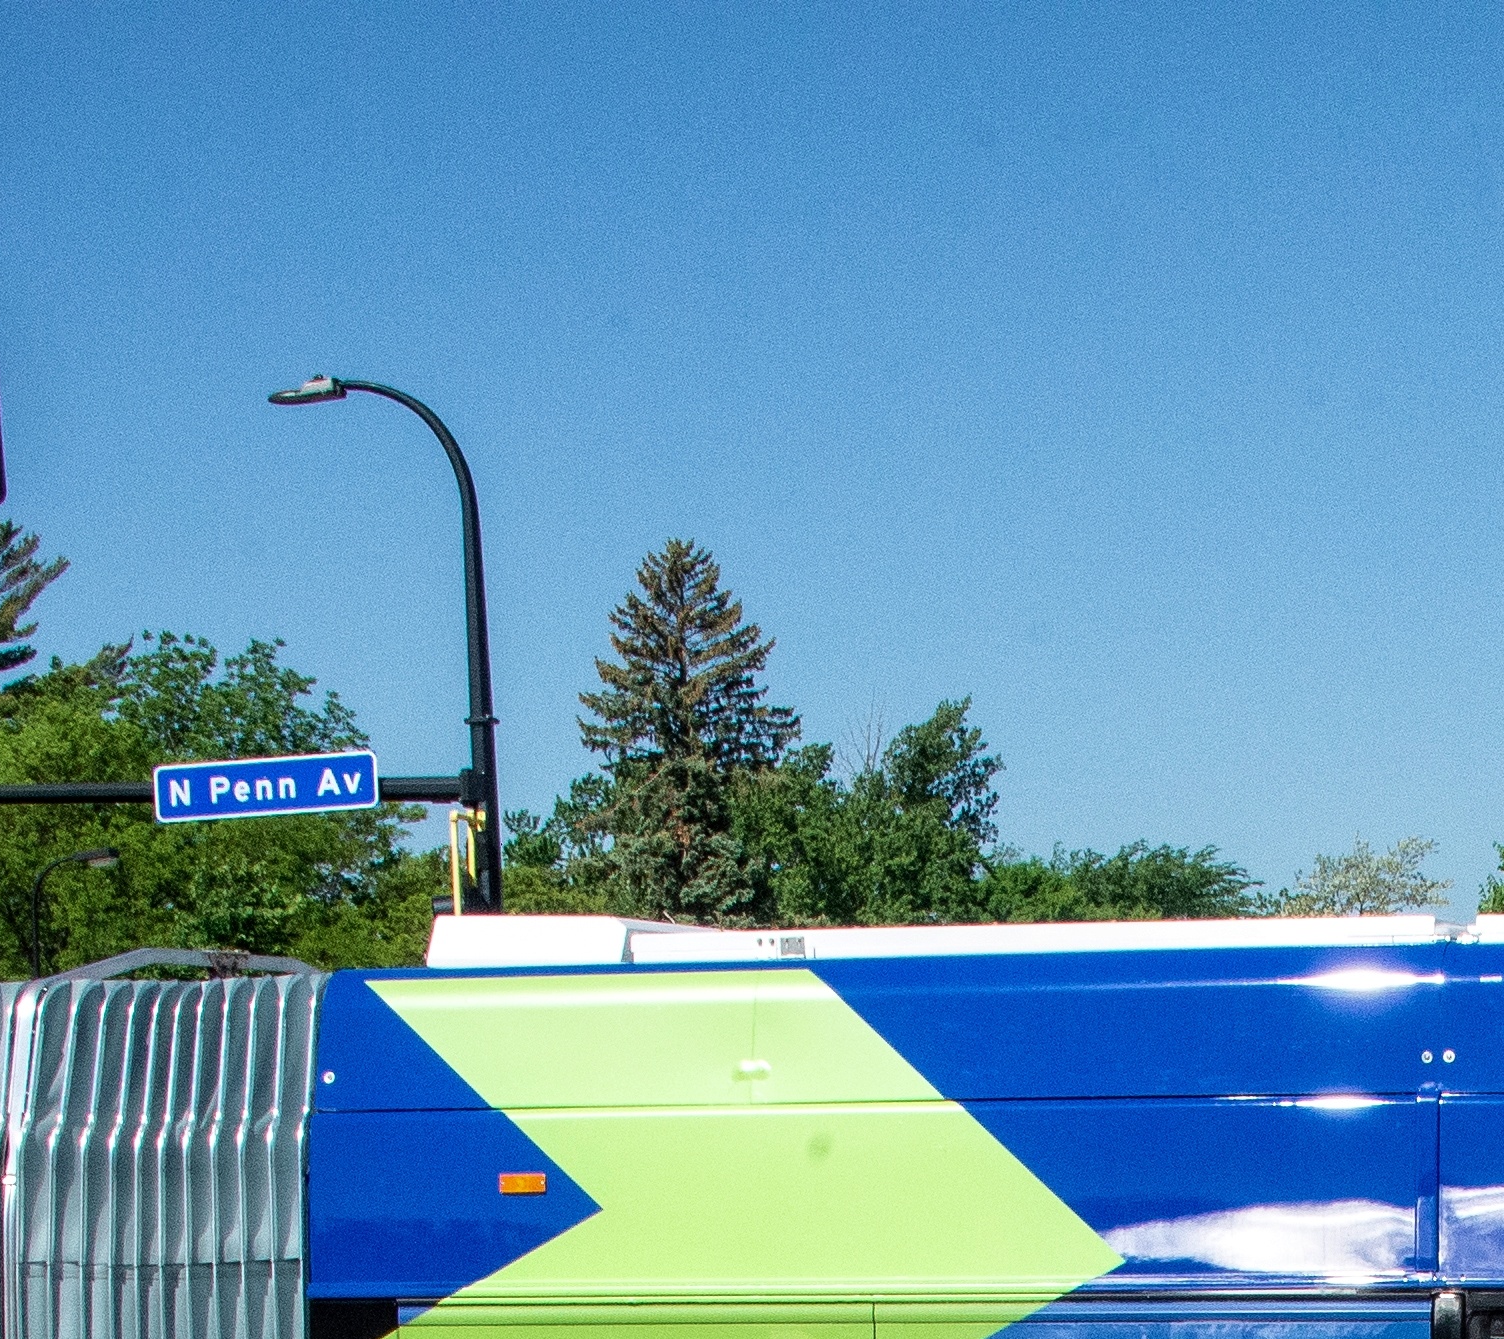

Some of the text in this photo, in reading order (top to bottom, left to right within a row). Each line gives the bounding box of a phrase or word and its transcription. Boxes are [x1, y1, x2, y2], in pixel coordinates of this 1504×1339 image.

[169, 767, 361, 807] N Penn Av
